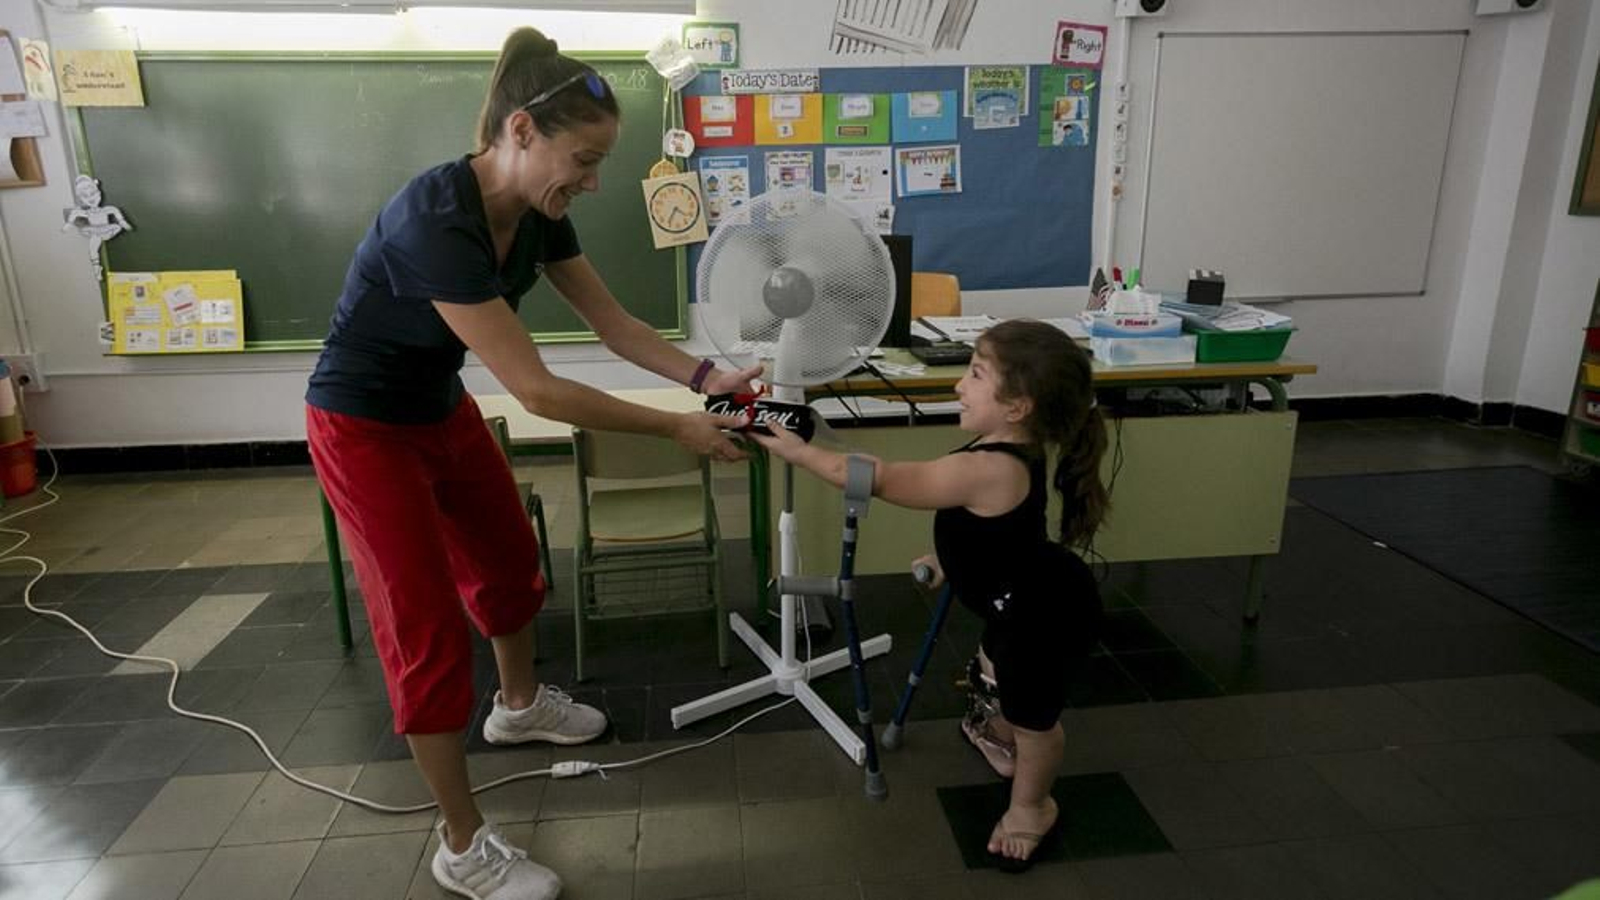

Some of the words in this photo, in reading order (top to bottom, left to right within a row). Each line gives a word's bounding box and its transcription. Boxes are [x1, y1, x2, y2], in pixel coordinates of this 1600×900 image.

[687, 37, 713, 51] Left
[1077, 38, 1102, 54] Right
[729, 73, 777, 89] Today's
[780, 73, 813, 88] Date
